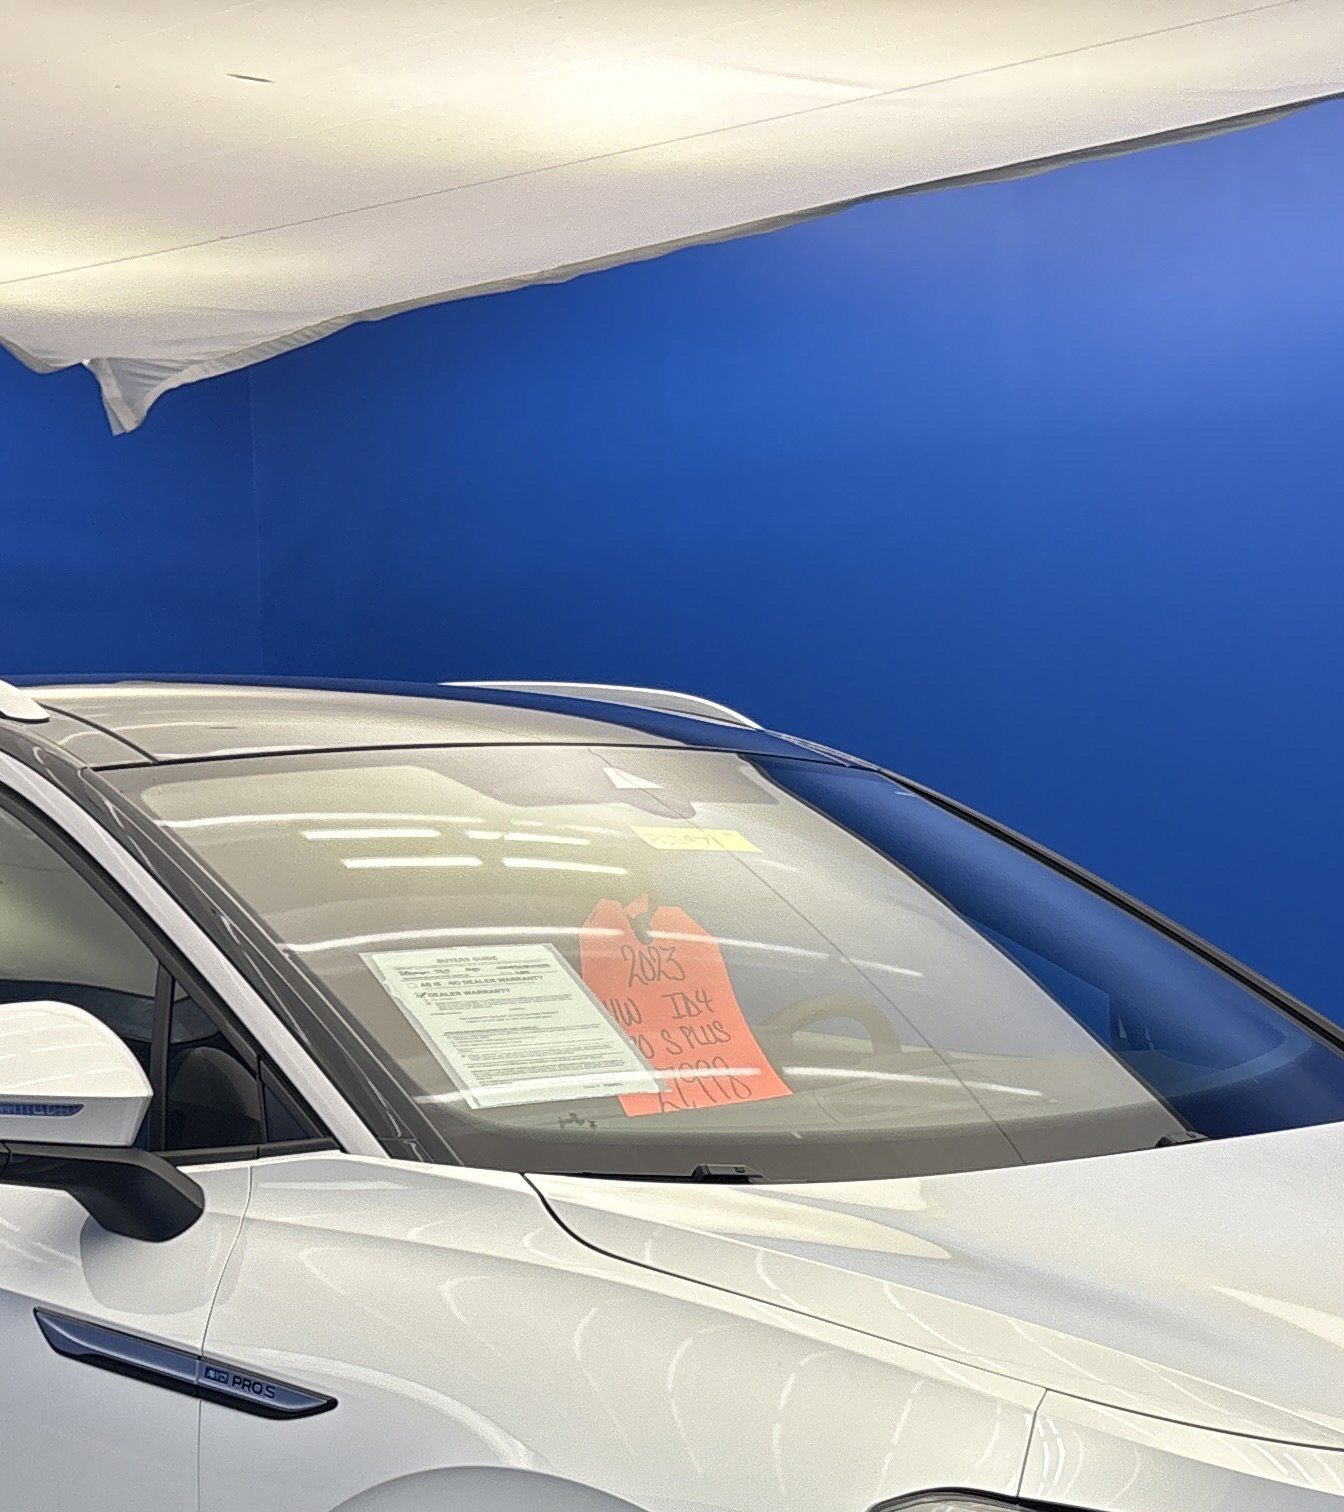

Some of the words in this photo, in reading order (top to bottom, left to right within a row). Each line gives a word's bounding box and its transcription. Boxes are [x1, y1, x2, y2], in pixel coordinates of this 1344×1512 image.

[621, 944, 687, 988] 2023
[660, 1029, 683, 1055] S
[680, 1020, 731, 1049] PLUS
[231, 1375, 263, 1395] PRO
[264, 1384, 277, 1399] S
